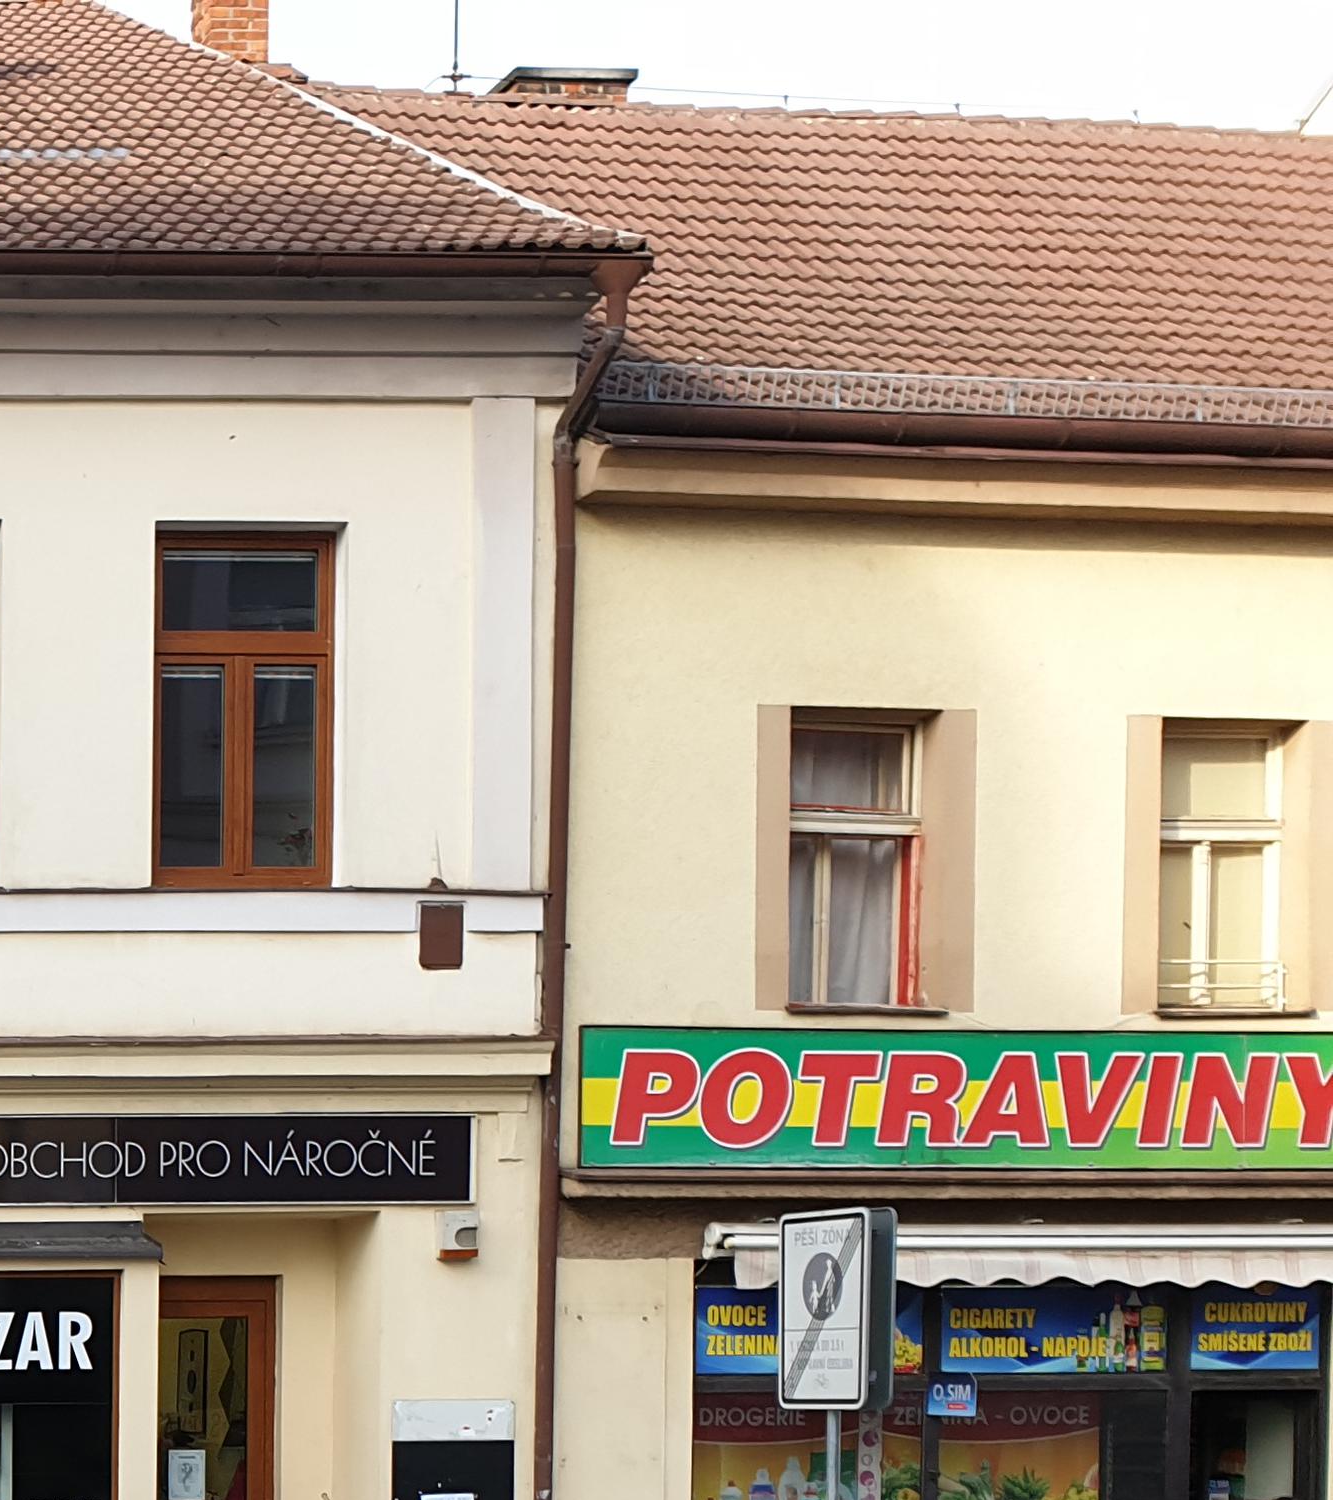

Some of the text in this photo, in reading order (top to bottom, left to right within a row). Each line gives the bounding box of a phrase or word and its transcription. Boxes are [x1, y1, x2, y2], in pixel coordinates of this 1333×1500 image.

[608, 1047, 1333, 1149] POTRAVINY
[159, 1139, 231, 1178] PRO
[244, 1129, 436, 1177] NÁROČNÉ
[706, 1305, 767, 1327] OVOCE
[949, 1308, 1036, 1329] CIGARETY
[1204, 1301, 1308, 1323] CUKROVINY
[949, 1336, 1029, 1358] ALKOHOL
[1042, 1333, 1108, 1358] NÁPOJE
[1198, 1329, 1313, 1352] SMÍŠENÉ ZBOŽÍ
[947, 1384, 971, 1401] SIM
[699, 1406, 806, 1426] DROGERIE
[1009, 1406, 1089, 1426] OVOCE
